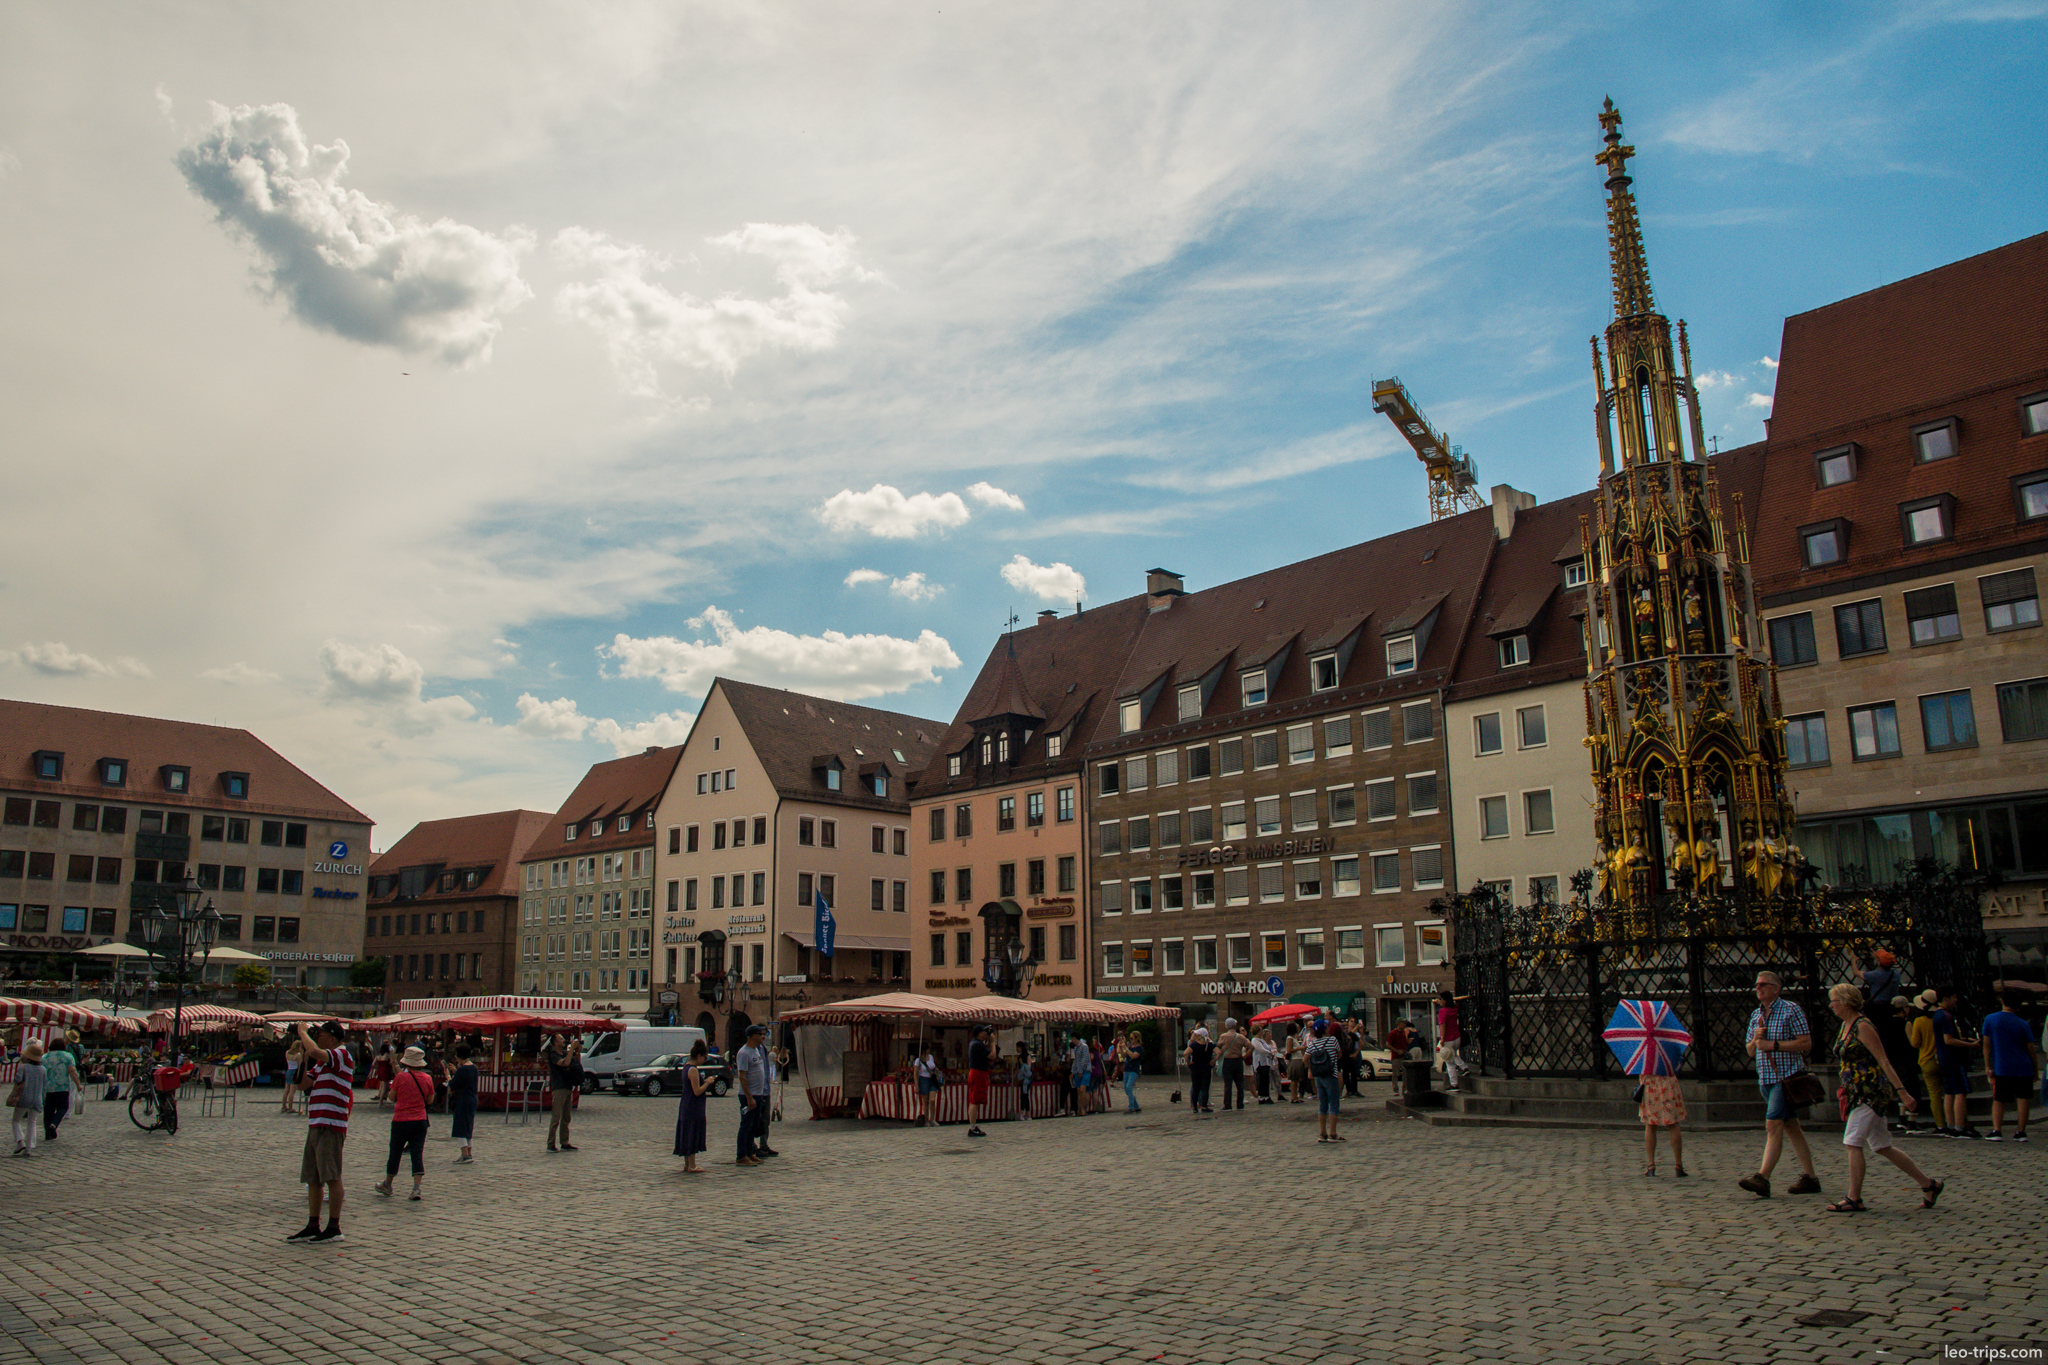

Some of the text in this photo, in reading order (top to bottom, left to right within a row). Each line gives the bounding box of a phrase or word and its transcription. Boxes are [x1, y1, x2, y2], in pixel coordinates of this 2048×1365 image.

[1246, 837, 1335, 859] IMMOBILIEN
[314, 862, 362, 875] ZURICH
[313, 887, 359, 899] Tucher
[664, 916, 695, 929] Spalter
[727, 914, 765, 924] Restaurant
[727, 925, 765, 937] Hauptmarkt
[9, 934, 94, 949] PROVENZA
[261, 950, 320, 961] HÖRGERÄTE
[925, 979, 948, 988] KORN
[955, 978, 977, 988] BERG
[1034, 974, 1072, 986] BÜCHER
[1096, 984, 1160, 993] JUWELIER AM HAUPTMARKT
[1381, 982, 1439, 995] LINCURA
[592, 1002, 606, 1011] Casa
